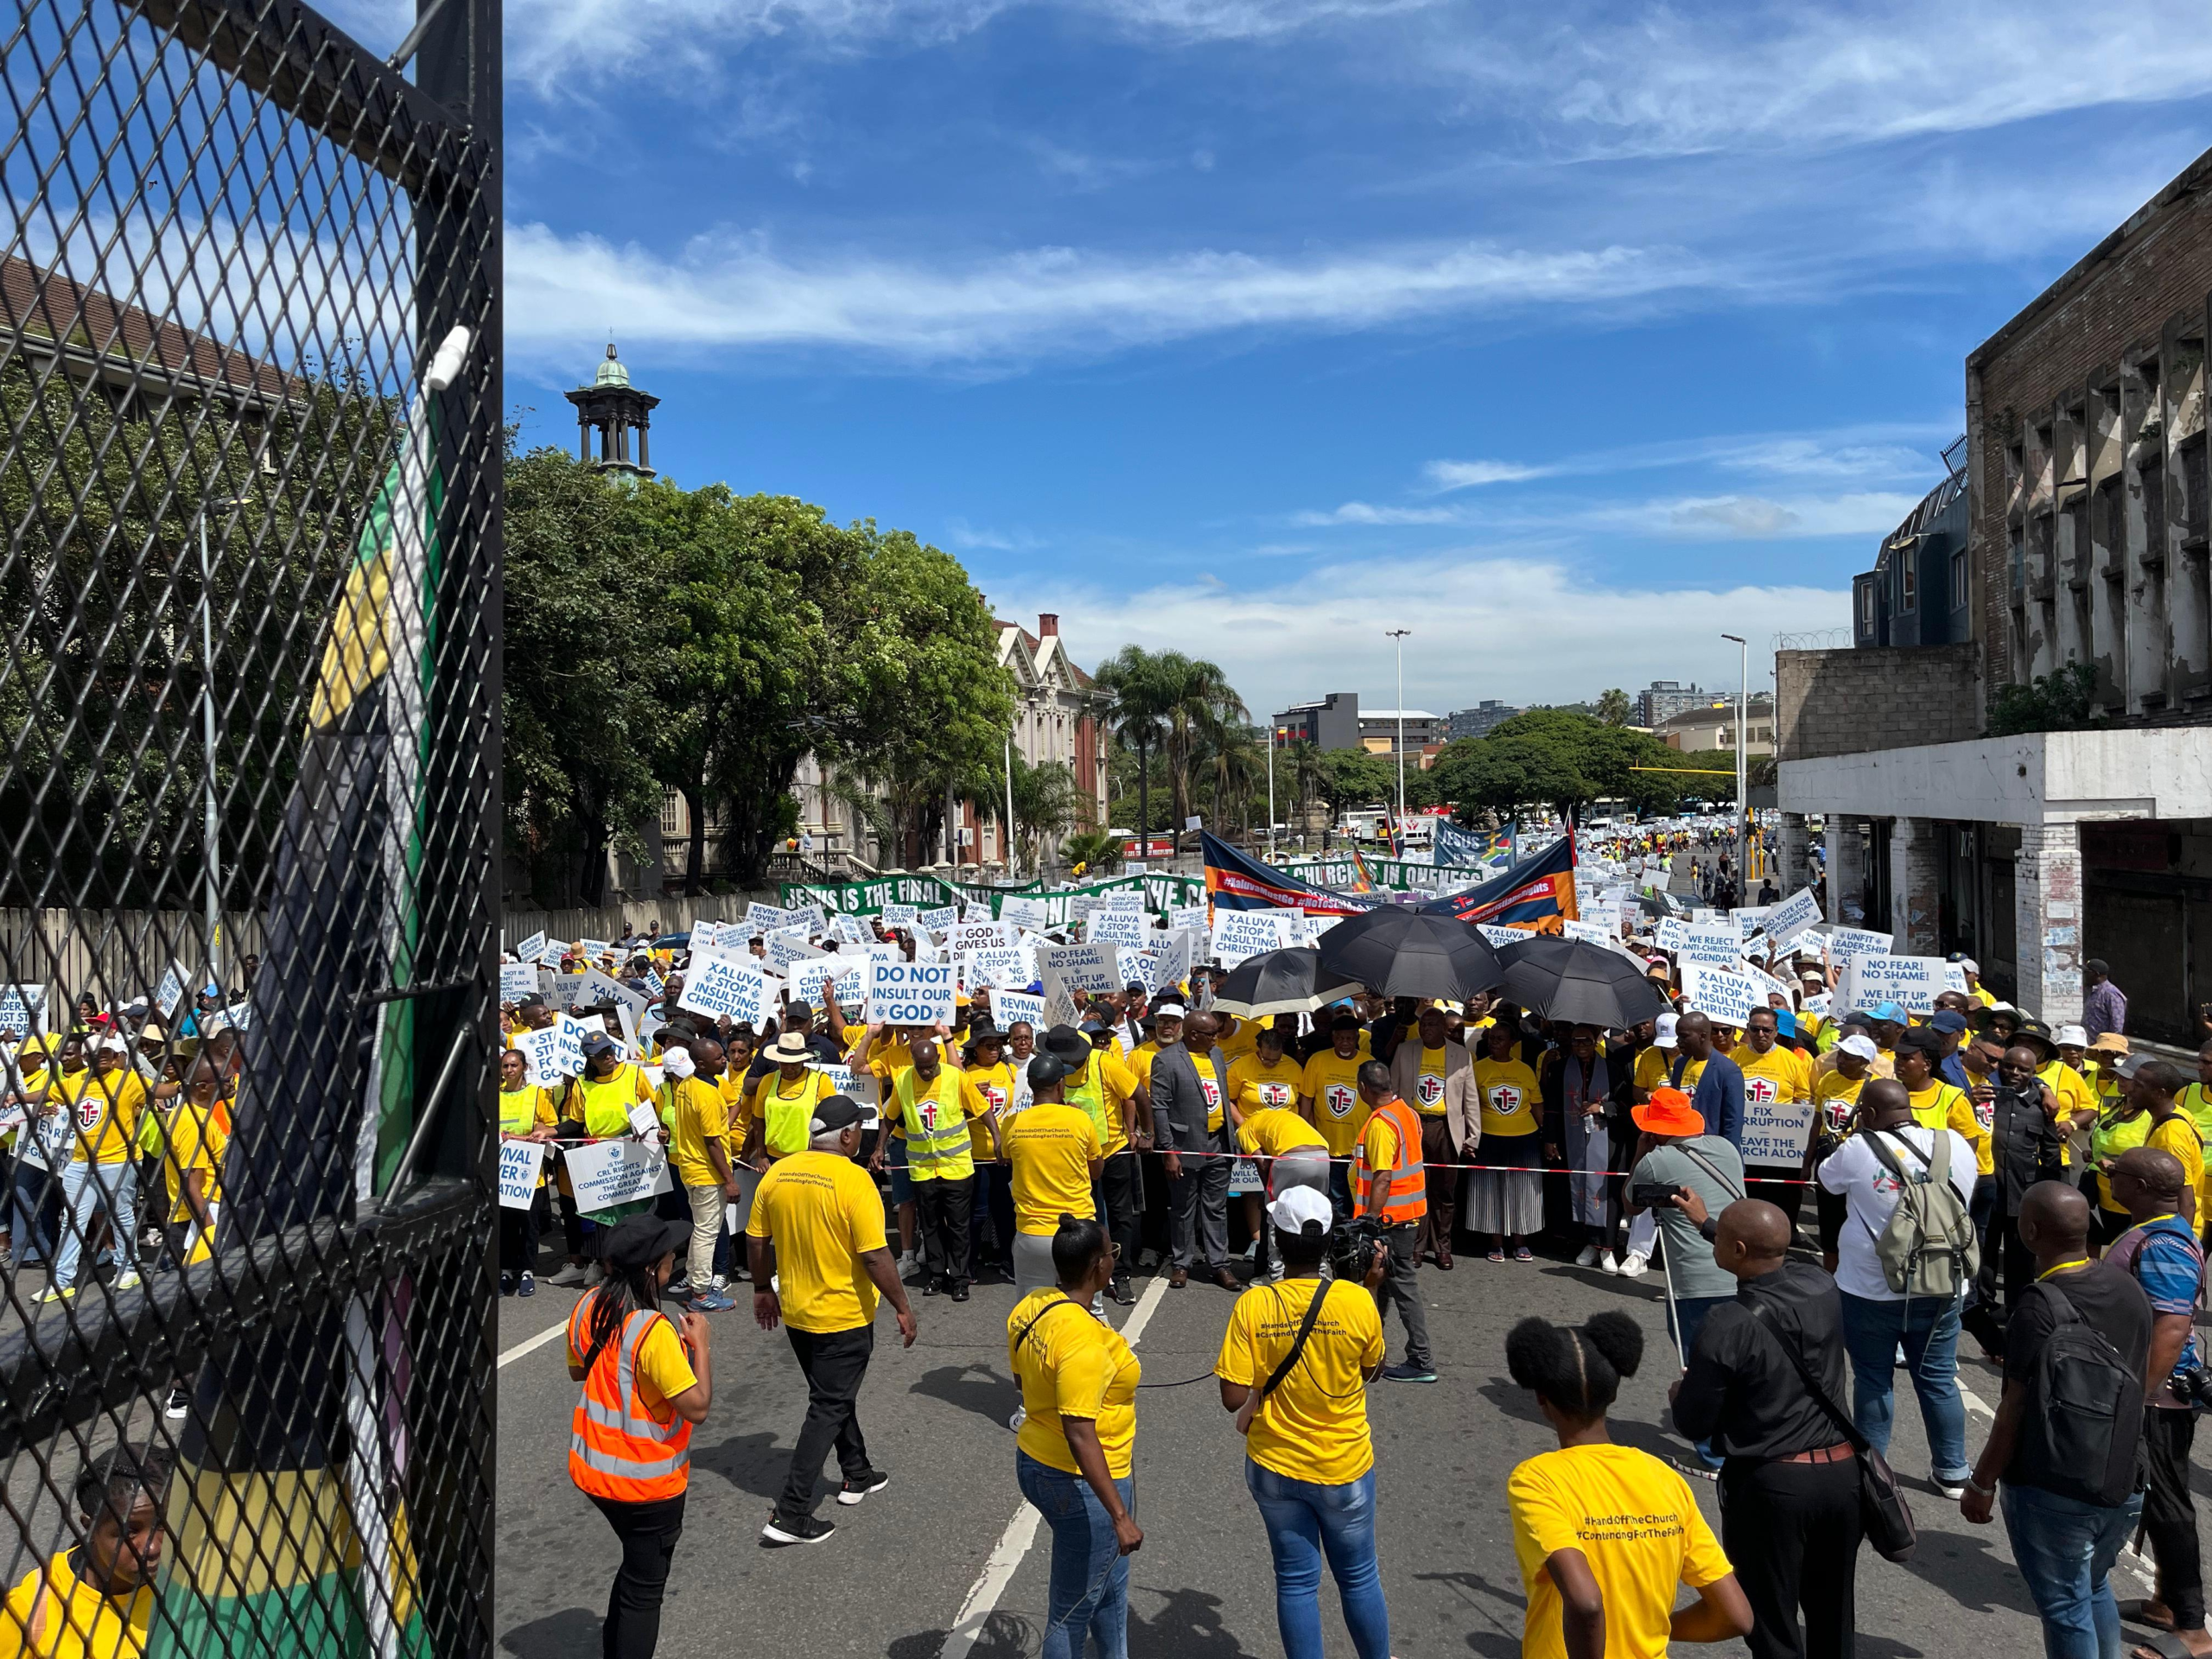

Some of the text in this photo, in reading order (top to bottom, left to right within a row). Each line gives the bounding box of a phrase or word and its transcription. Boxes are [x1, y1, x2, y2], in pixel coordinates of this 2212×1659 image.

[1440, 830, 1480, 849] JESUS
[1383, 865, 1401, 885] IN
[785, 879, 944, 912] JESUS IS THE FINAL
[755, 913, 777, 923] OVER
[785, 908, 815, 921] XALUVA
[938, 908, 954, 917] FEAR
[1099, 914, 1139, 923] XALUVA
[1764, 896, 1811, 930] NO VOTE FOR
[1767, 901, 1814, 934] ANTI-CHRISTIAN
[792, 916, 810, 925] STOP
[923, 913, 957, 927] GOD NOT
[1227, 914, 1276, 928] XALUVA
[1775, 912, 1809, 938] AGENDAS
[965, 928, 994, 938] GOD
[1094, 931, 1141, 940] INSULTING
[1236, 925, 1264, 937] STOP
[1487, 928, 1525, 939] XALUVA
[521, 936, 541, 950] REVIVAL
[956, 938, 1005, 950] GIVES US
[1090, 938, 1143, 949] CHRISTIANS
[1220, 932, 1278, 948] INSULTING
[1688, 935, 1734, 946] WE REJECT
[1750, 939, 1761, 948] NO
[1847, 932, 1874, 944] UNFIT
[583, 942, 606, 950] REVIVAL
[772, 943, 806, 960] NO VOTE
[1681, 943, 1740, 954] ANTI-CHRISTIAN
[1750, 945, 1761, 954] NO
[1777, 942, 1801, 957] NAME!
[1832, 939, 1889, 955] LEADERSHIP
[1069, 948, 1096, 958] FEAR!
[1169, 951, 1181, 967] NOT
[1690, 953, 1733, 963] AGENDAS
[1048, 957, 1104, 968] NO SHAME!
[1867, 960, 1923, 970] NO FEAR!
[708, 961, 763, 989] XALUVA
[850, 972, 861, 981] IS
[876, 966, 950, 983] DO NOT
[1071, 975, 1090, 983] LIFT
[1698, 970, 1753, 991] XALUVA
[1861, 969, 1929, 981] NO SHAME!
[556, 982, 569, 992] OUR
[715, 977, 748, 995] STOP
[1083, 981, 1114, 991] NAME!
[1751, 968, 1784, 995] XALUVA
[801, 985, 823, 995] NOT
[873, 988, 951, 1001] INSULT OUR
[1711, 984, 1742, 997] STOP
[1864, 989, 1928, 1001] WE LIFT UP
[695, 982, 760, 1011] INSULTING
[687, 992, 760, 1025] CHRISTIANS
[1001, 996, 1043, 1013] REVIVAL
[1690, 1001, 1749, 1020] CHRISTIA
[1898, 1000, 1934, 1011] NAME!
[889, 1004, 933, 1020] GOD
[1007, 1011, 1036, 1023] OVER
[829, 1071, 860, 1081] FEAR!
[1754, 1108, 1773, 1116] FIX
[1744, 1117, 1804, 1128] RRUPTION
[1740, 1137, 1795, 1148] EAVE THE
[597, 1161, 640, 1178] CRL RIGHTS
[578, 1164, 662, 1190] COMMISSION AGAINST
[602, 1178, 641, 1192] THE GREAT
[597, 1183, 650, 1201] COMMISSION?
[1584, 1512, 1678, 1527] #HandsOffTheChurch
[1576, 1525, 1684, 1541] #ContendingForTheFaith
